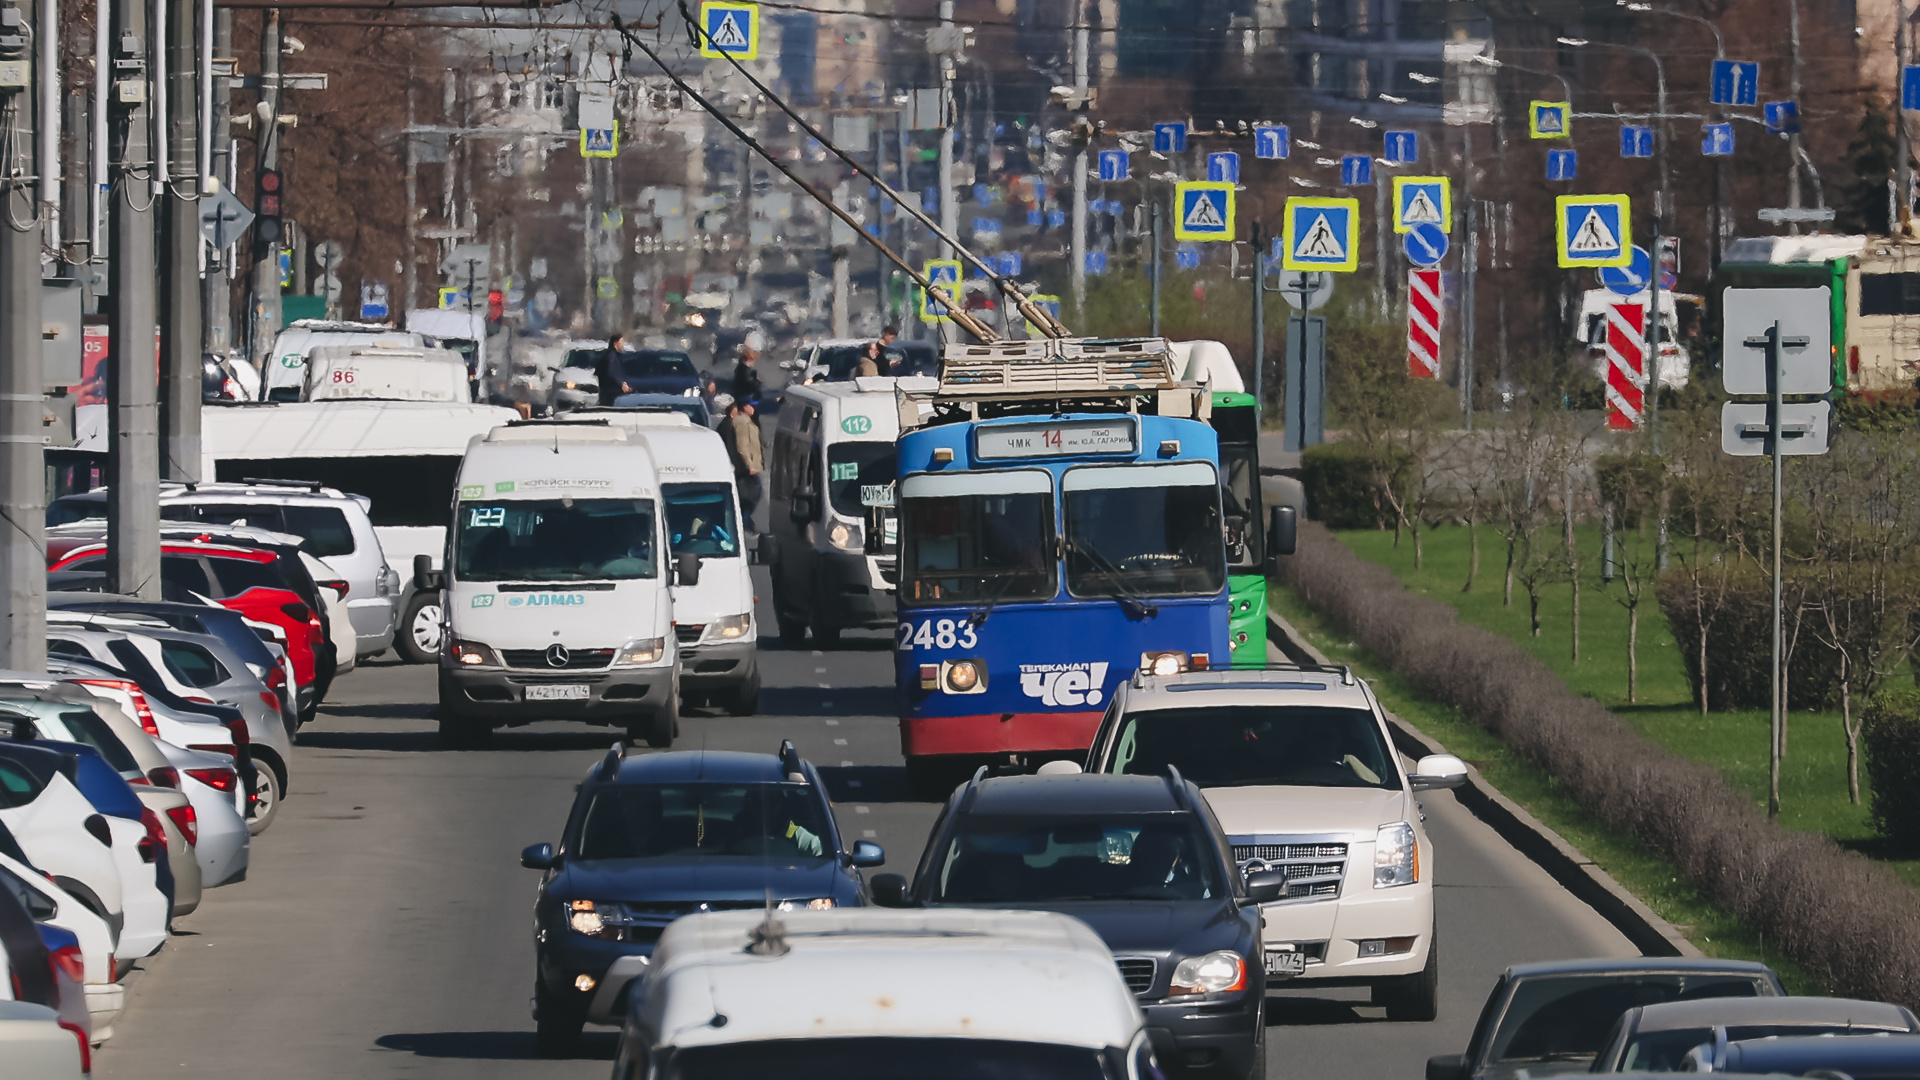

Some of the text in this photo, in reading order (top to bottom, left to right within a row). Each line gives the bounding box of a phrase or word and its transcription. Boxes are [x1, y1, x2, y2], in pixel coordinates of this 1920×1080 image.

[333, 371, 354, 383] 86
[845, 417, 868, 432] 112
[1007, 430, 1062, 448] ЧМК 14
[832, 463, 858, 480] 112
[463, 487, 482, 498] 123
[470, 507, 505, 526] 123
[474, 595, 493, 606] 123
[526, 594, 585, 606] АЛМАЗ
[900, 619, 978, 650] 2483
[1019, 663, 1089, 673] ТЕЛЕКАНАЛ
[1278, 954, 1301, 966] 174
